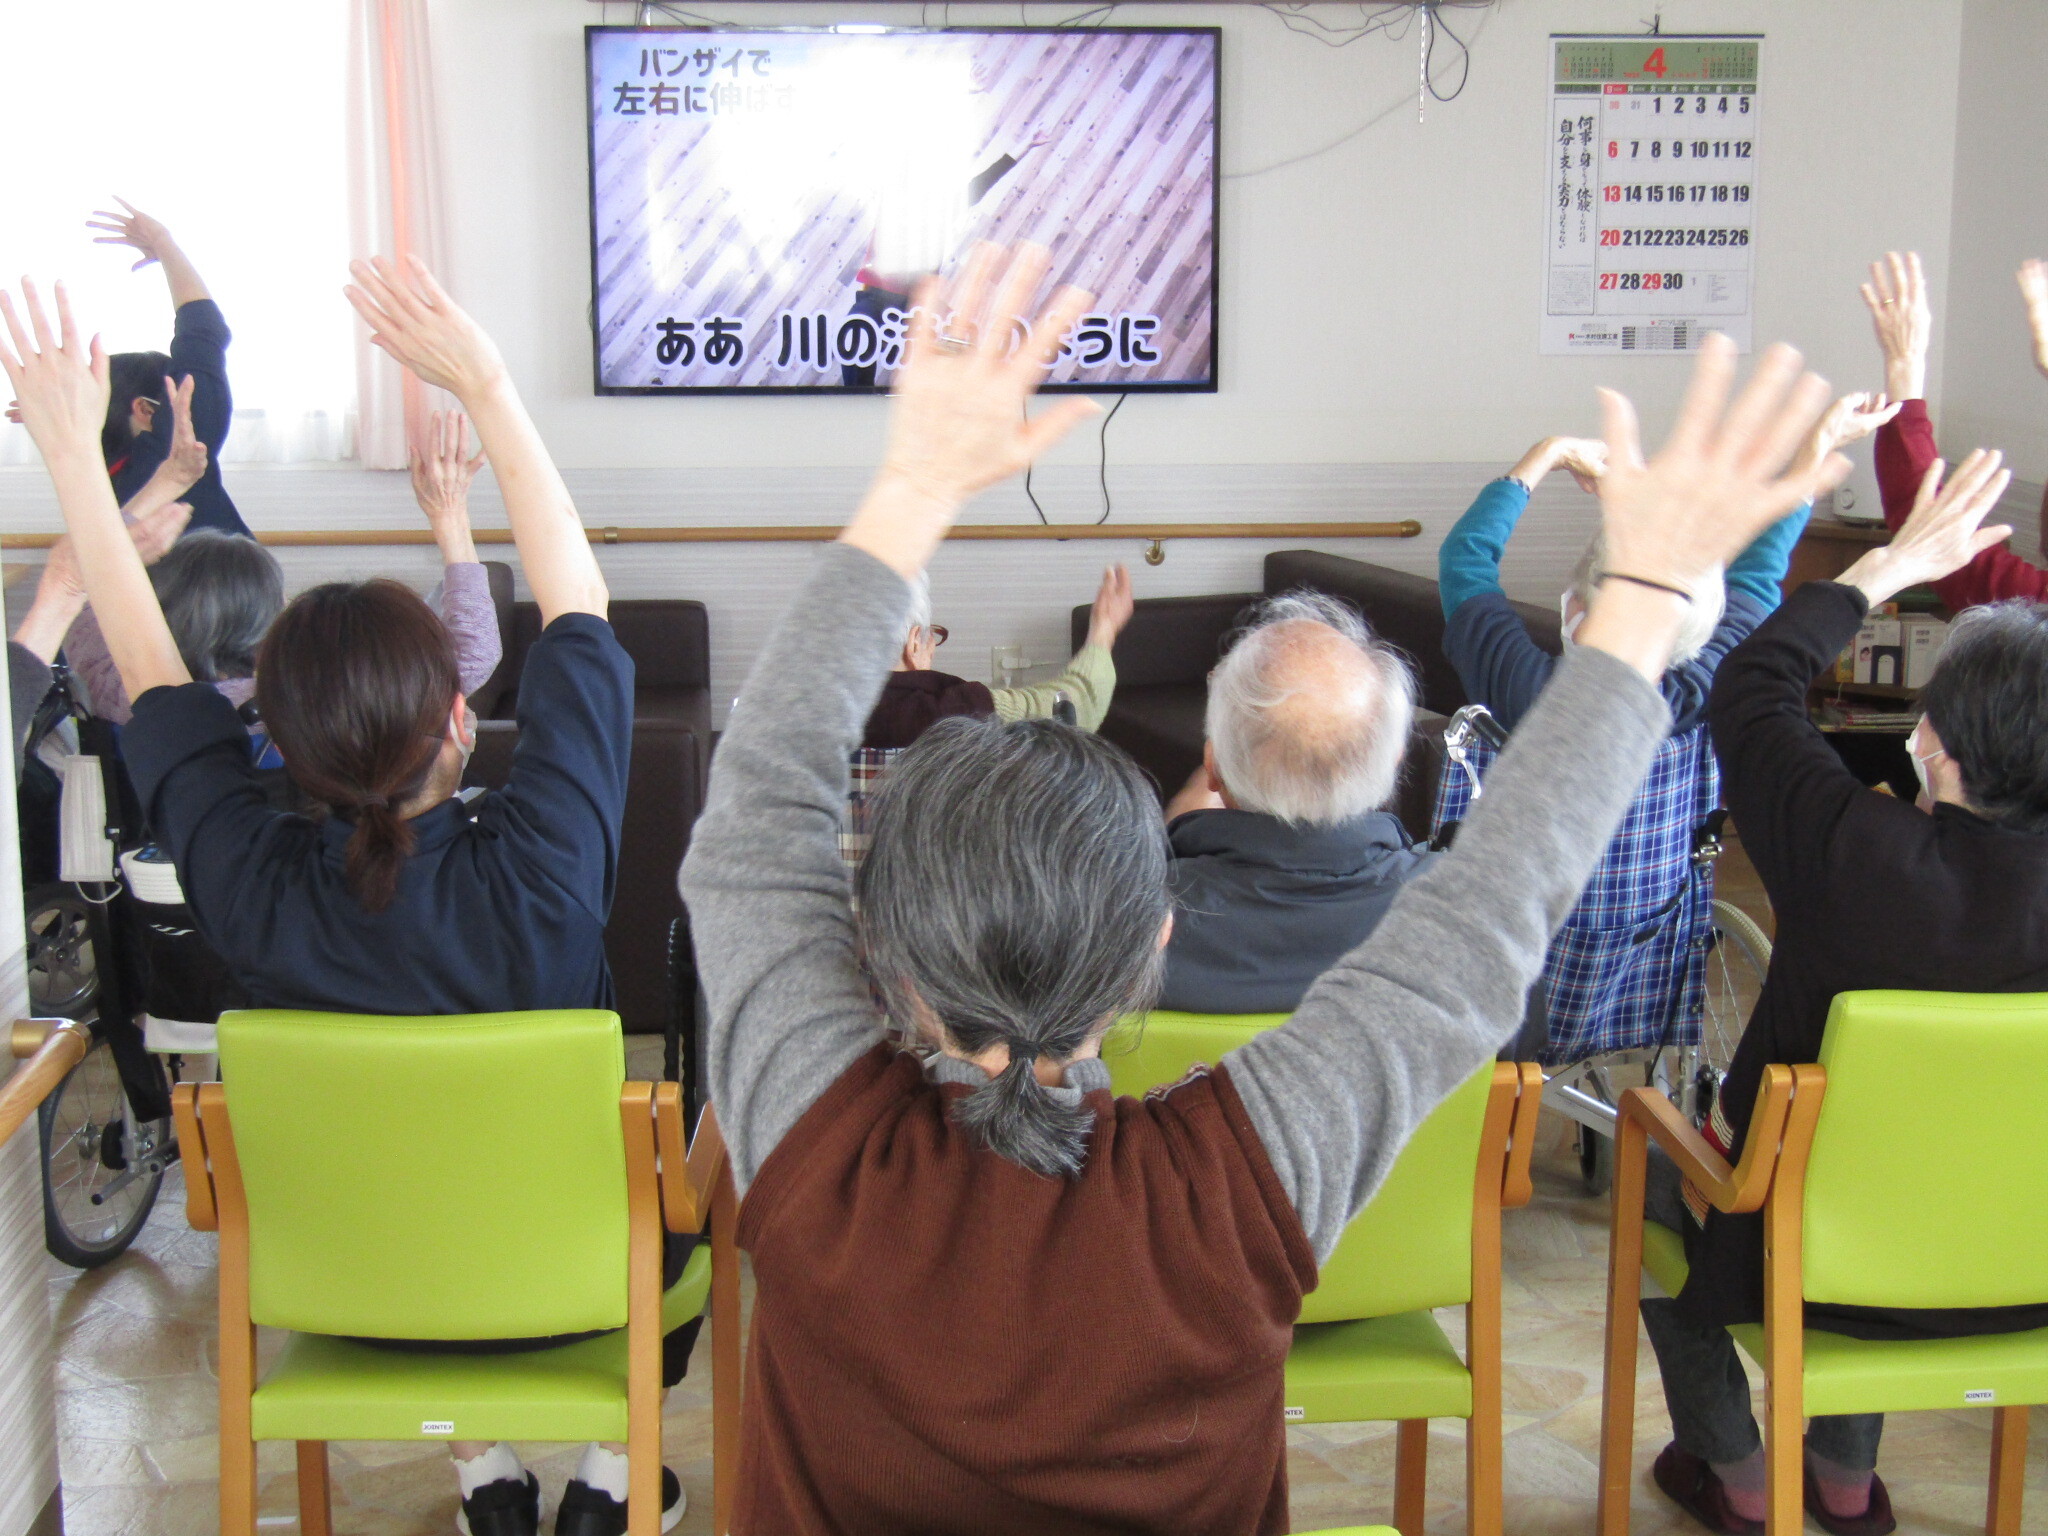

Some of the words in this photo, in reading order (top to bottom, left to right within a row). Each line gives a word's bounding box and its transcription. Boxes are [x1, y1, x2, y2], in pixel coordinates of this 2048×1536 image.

[639, 47, 771, 77] バンザイで
[1643, 47, 1667, 78] 4
[1653, 97, 1661, 113] 1
[1674, 97, 1684, 113] 2
[1696, 97, 1706, 113] 3
[1718, 97, 1728, 113] 4
[1740, 97, 1750, 113] 5
[1608, 141, 1618, 158] 6
[1630, 141, 1640, 158] 7
[1651, 141, 1661, 158] 8
[1673, 141, 1683, 158] 9
[1690, 141, 1709, 158] 10
[1713, 141, 1730, 158] 11
[1734, 141, 1752, 158] 12
[1603, 185, 1621, 202] 13
[1624, 185, 1642, 202] 14
[1646, 185, 1663, 202] 15
[1667, 185, 1685, 202] 16
[1690, 185, 1706, 202] 17
[1711, 185, 1728, 202] 18
[1732, 185, 1750, 202] 19
[1600, 229, 1621, 246] 20
[1622, 229, 1641, 246] 21
[1643, 229, 1663, 246] 22
[1664, 229, 1685, 246] 23
[1686, 229, 1706, 246] 24
[1707, 229, 1728, 246] 25
[1729, 229, 1749, 246] 26
[1599, 273, 1618, 290] 27
[1620, 273, 1640, 290] 28
[1642, 273, 1662, 290] 29
[1663, 273, 1683, 290] 30
[656, 317, 744, 367] ああ
